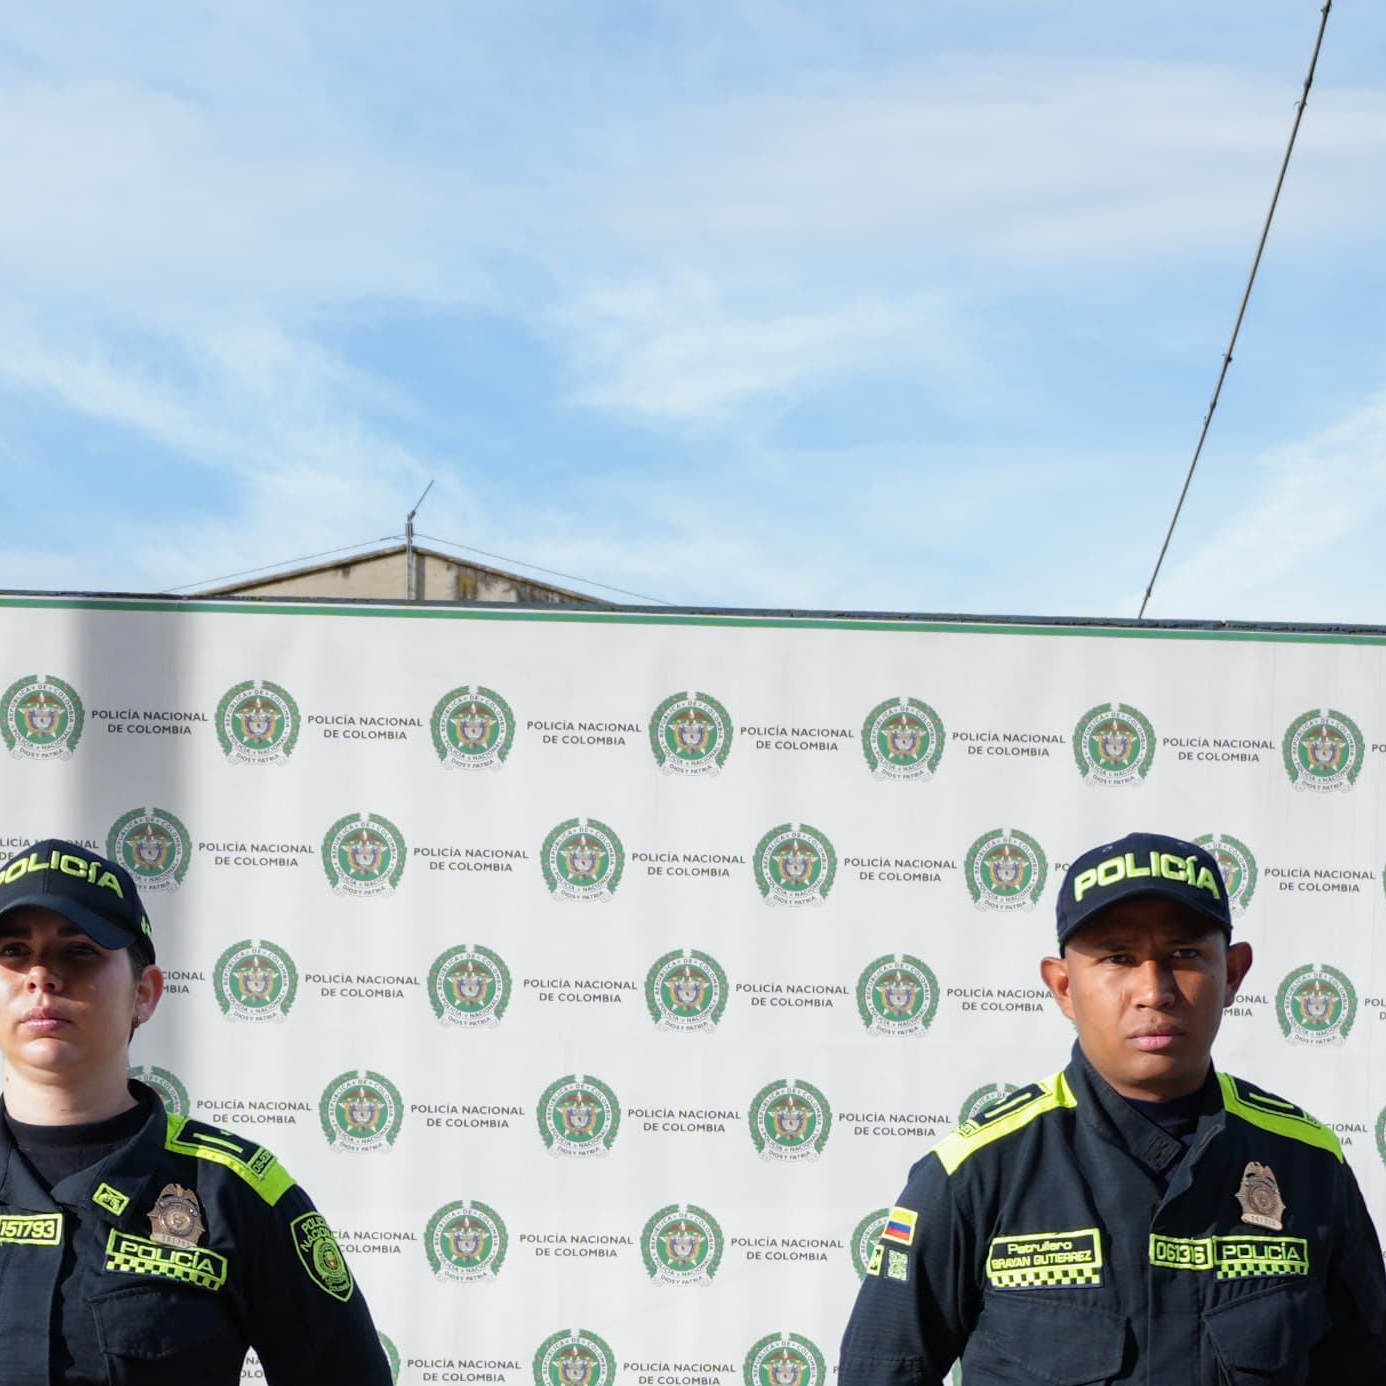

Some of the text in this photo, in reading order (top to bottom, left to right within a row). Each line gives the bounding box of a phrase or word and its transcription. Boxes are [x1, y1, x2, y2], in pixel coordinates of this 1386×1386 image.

[91, 708, 209, 723] POLICÍA NACIONAL
[107, 723, 193, 736] DE COLOMBIA
[526, 719, 643, 733] POLICÍA NACIONAL
[542, 734, 627, 746] DE COLOMBIA
[951, 730, 1067, 745] POLICÍA NACIONAL
[967, 745, 1050, 758] DE COLOMBIA
[198, 840, 316, 855] POLICÍA NACIONAL
[214, 855, 299, 868] DE COLOMBIA
[631, 850, 747, 865] POLICÍA NACIONAL
[646, 865, 731, 878] DE COLOMBIA
[1073, 850, 1221, 902] POLICÍA
[1263, 866, 1377, 881] POLICÍA NACIONAL
[1278, 881, 1361, 894] DE COLOMBIA
[522, 976, 638, 991] POLICÍA NACIONAL
[538, 992, 622, 1004] DE COLOMBIA
[627, 1107, 742, 1121] POLICÍA NACIONAL
[642, 1121, 726, 1133] DE COLOMBIA
[0, 1220, 55, 1239] 151793
[519, 1231, 635, 1246] POLICÍA NACIONAL
[119, 1240, 215, 1275] POLICÍA
[535, 1247, 618, 1258] DE COLOMBIA
[1032, 1249, 1093, 1265] GUTIERREZ
[1221, 1241, 1302, 1261] POLICÍA
[406, 1357, 522, 1371] POLICÍA NACIONAL
[622, 1360, 737, 1374] POLICÍA NACIONAL
[422, 1370, 506, 1383] DE COLOMBIA
[638, 1375, 721, 1386] DE COLOMBIA
